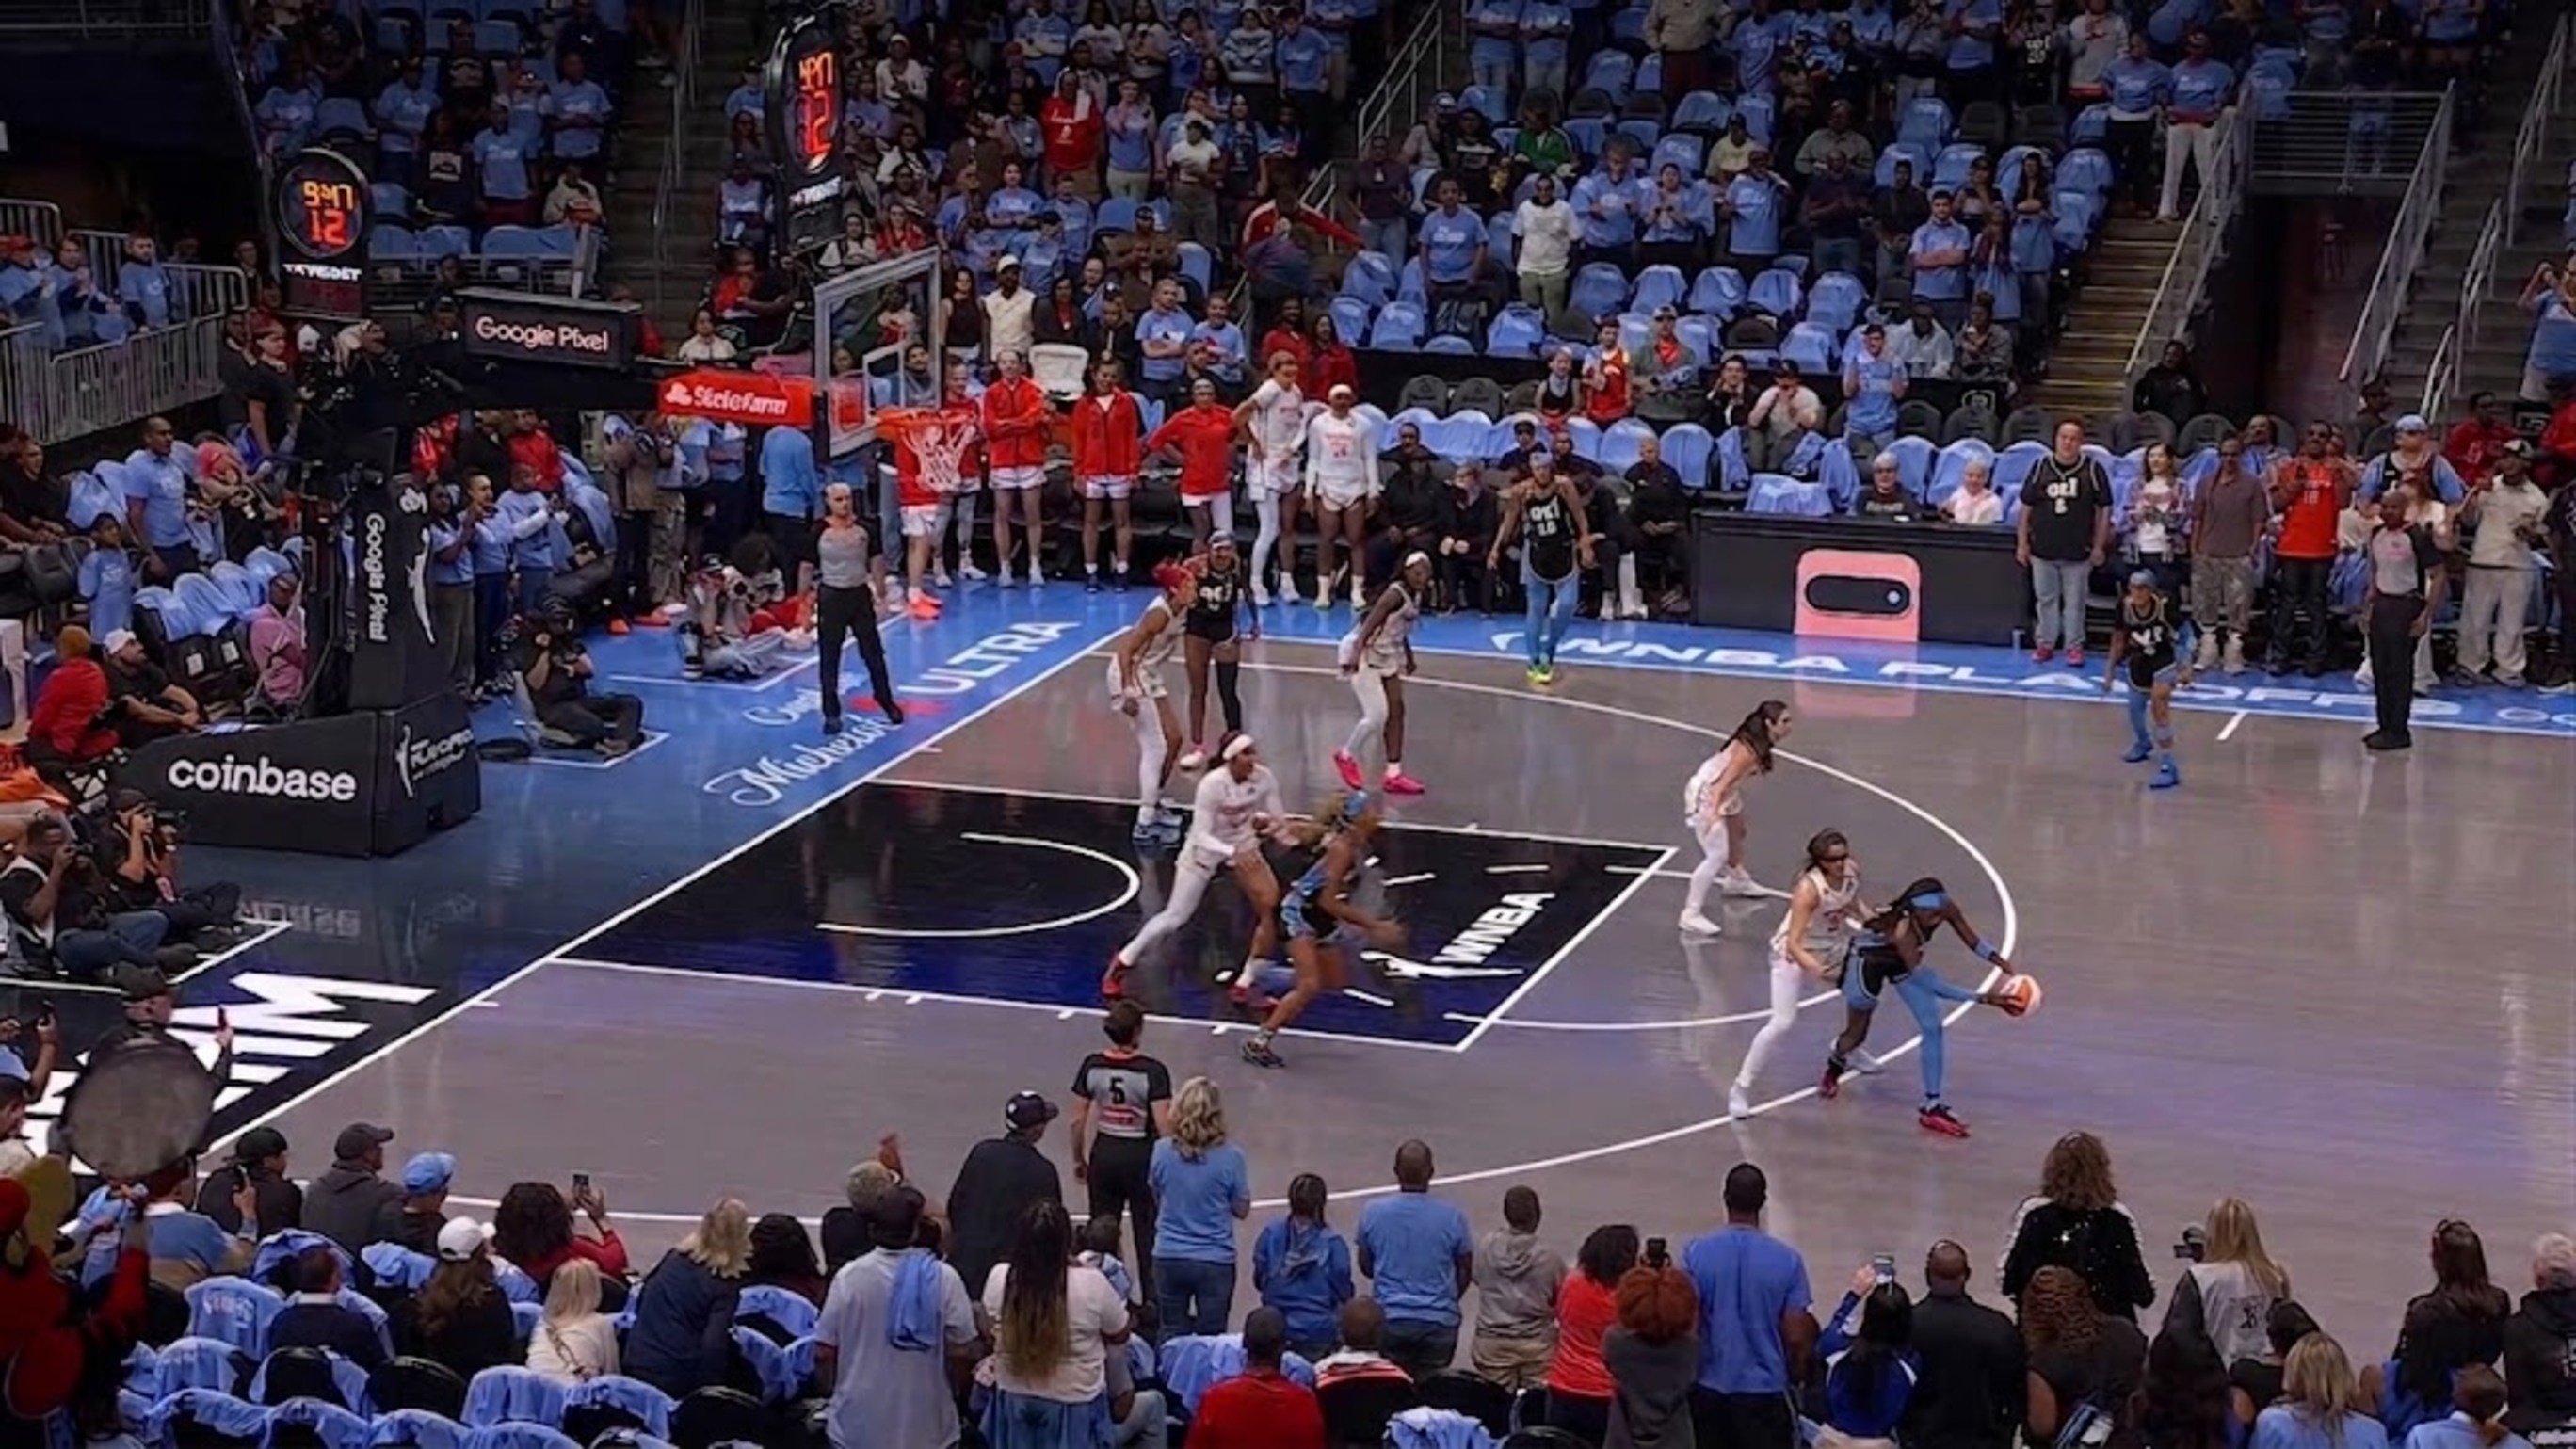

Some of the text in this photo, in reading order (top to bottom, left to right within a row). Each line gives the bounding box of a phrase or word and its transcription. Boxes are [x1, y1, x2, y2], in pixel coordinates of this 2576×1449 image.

[312, 210, 347, 246] 12
[475, 316, 608, 352] Google Pixel
[897, 621, 1082, 694] ULTRA
[169, 754, 357, 801] coinbase
[1431, 892, 1557, 965] WNBA
[1109, 1076, 1126, 1105] 5
